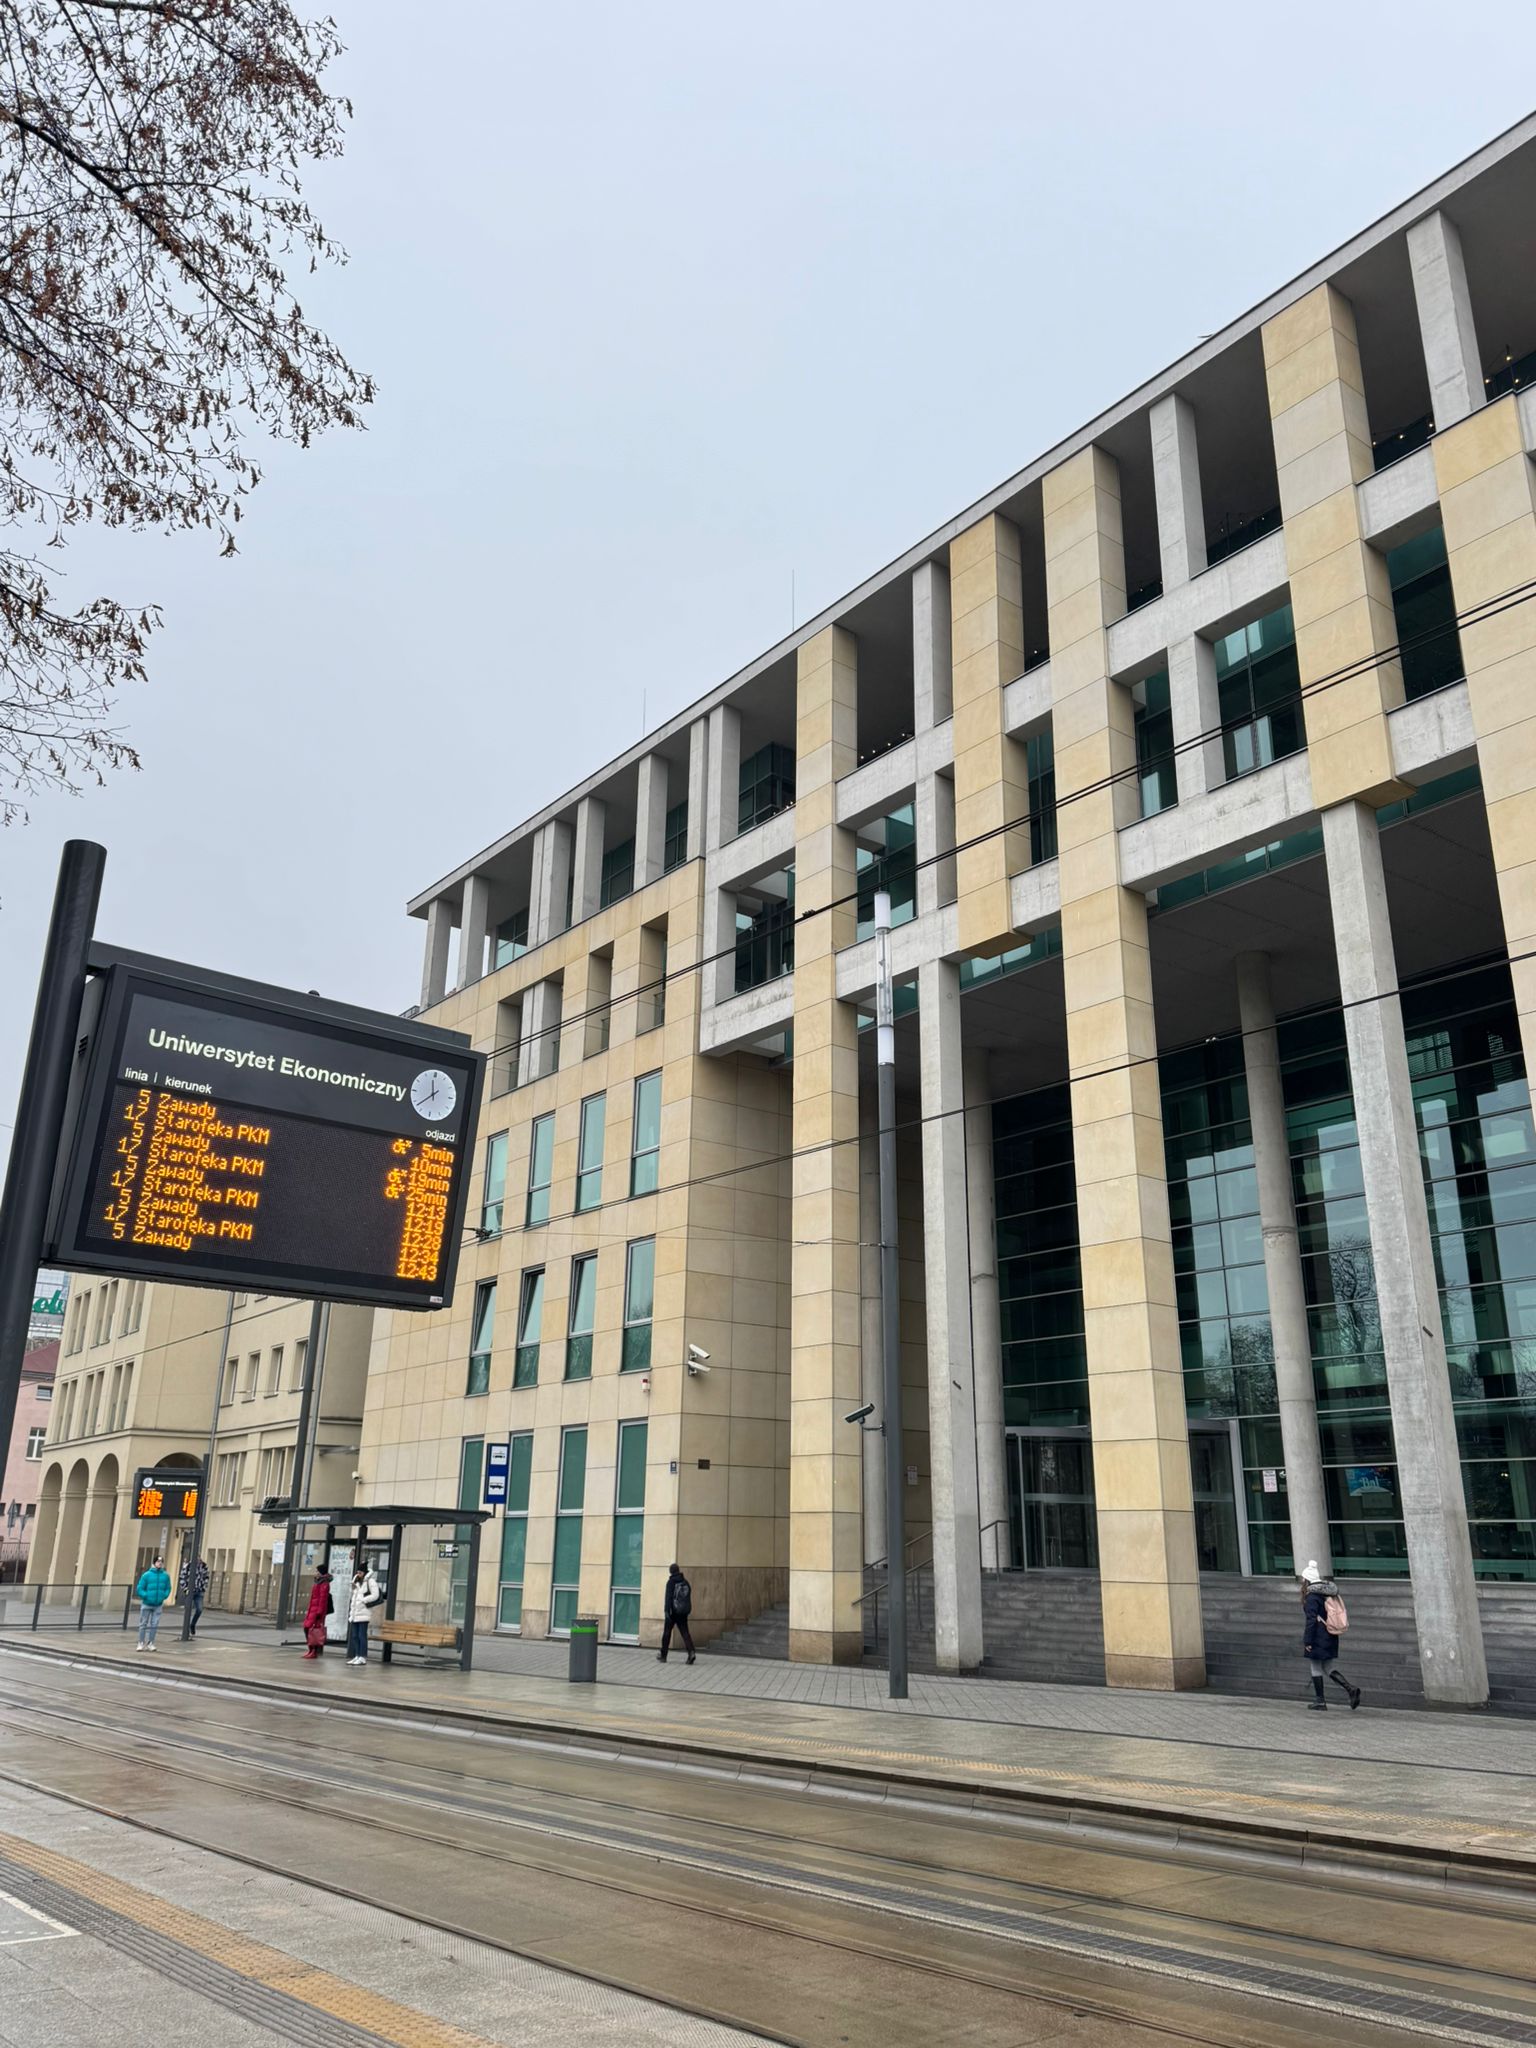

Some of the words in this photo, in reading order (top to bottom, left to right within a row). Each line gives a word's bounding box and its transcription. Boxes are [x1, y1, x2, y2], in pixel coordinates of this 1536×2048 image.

[124, 1067, 149, 1082] linia
[148, 1028, 275, 1071] Uniwersytet
[280, 1056, 408, 1101] Ekonomiczny
[165, 1075, 212, 1094] kierunek
[123, 1104, 149, 1121] 17
[237, 1124, 271, 1145] PKM
[410, 1157, 452, 1177] 10min
[132, 1122, 145, 1138] 5
[152, 1125, 210, 1152] Zawady
[408, 1173, 450, 1192] 19min
[139, 1089, 151, 1105] 5
[158, 1093, 216, 1119] Zawady
[421, 1143, 455, 1163] 5min
[425, 1129, 456, 1142] odjazd
[111, 1170, 135, 1187] 17
[225, 1188, 259, 1208] PKM
[404, 1218, 444, 1235] 12:19
[117, 1136, 142, 1154] 17
[231, 1156, 265, 1176] PKM
[405, 1187, 448, 1206] 25min
[126, 1155, 138, 1171] 5
[145, 1158, 204, 1185] Zawady
[407, 1202, 446, 1220] 12:13
[104, 1203, 129, 1221] 17
[220, 1220, 253, 1240] PKM
[399, 1248, 439, 1266] 12:34
[112, 1222, 126, 1239] 5
[132, 1225, 192, 1251] Zawady
[397, 1263, 437, 1281] 12:43
[119, 1188, 132, 1205] 5
[139, 1191, 198, 1218] Zawady
[402, 1233, 442, 1250] 12:28
